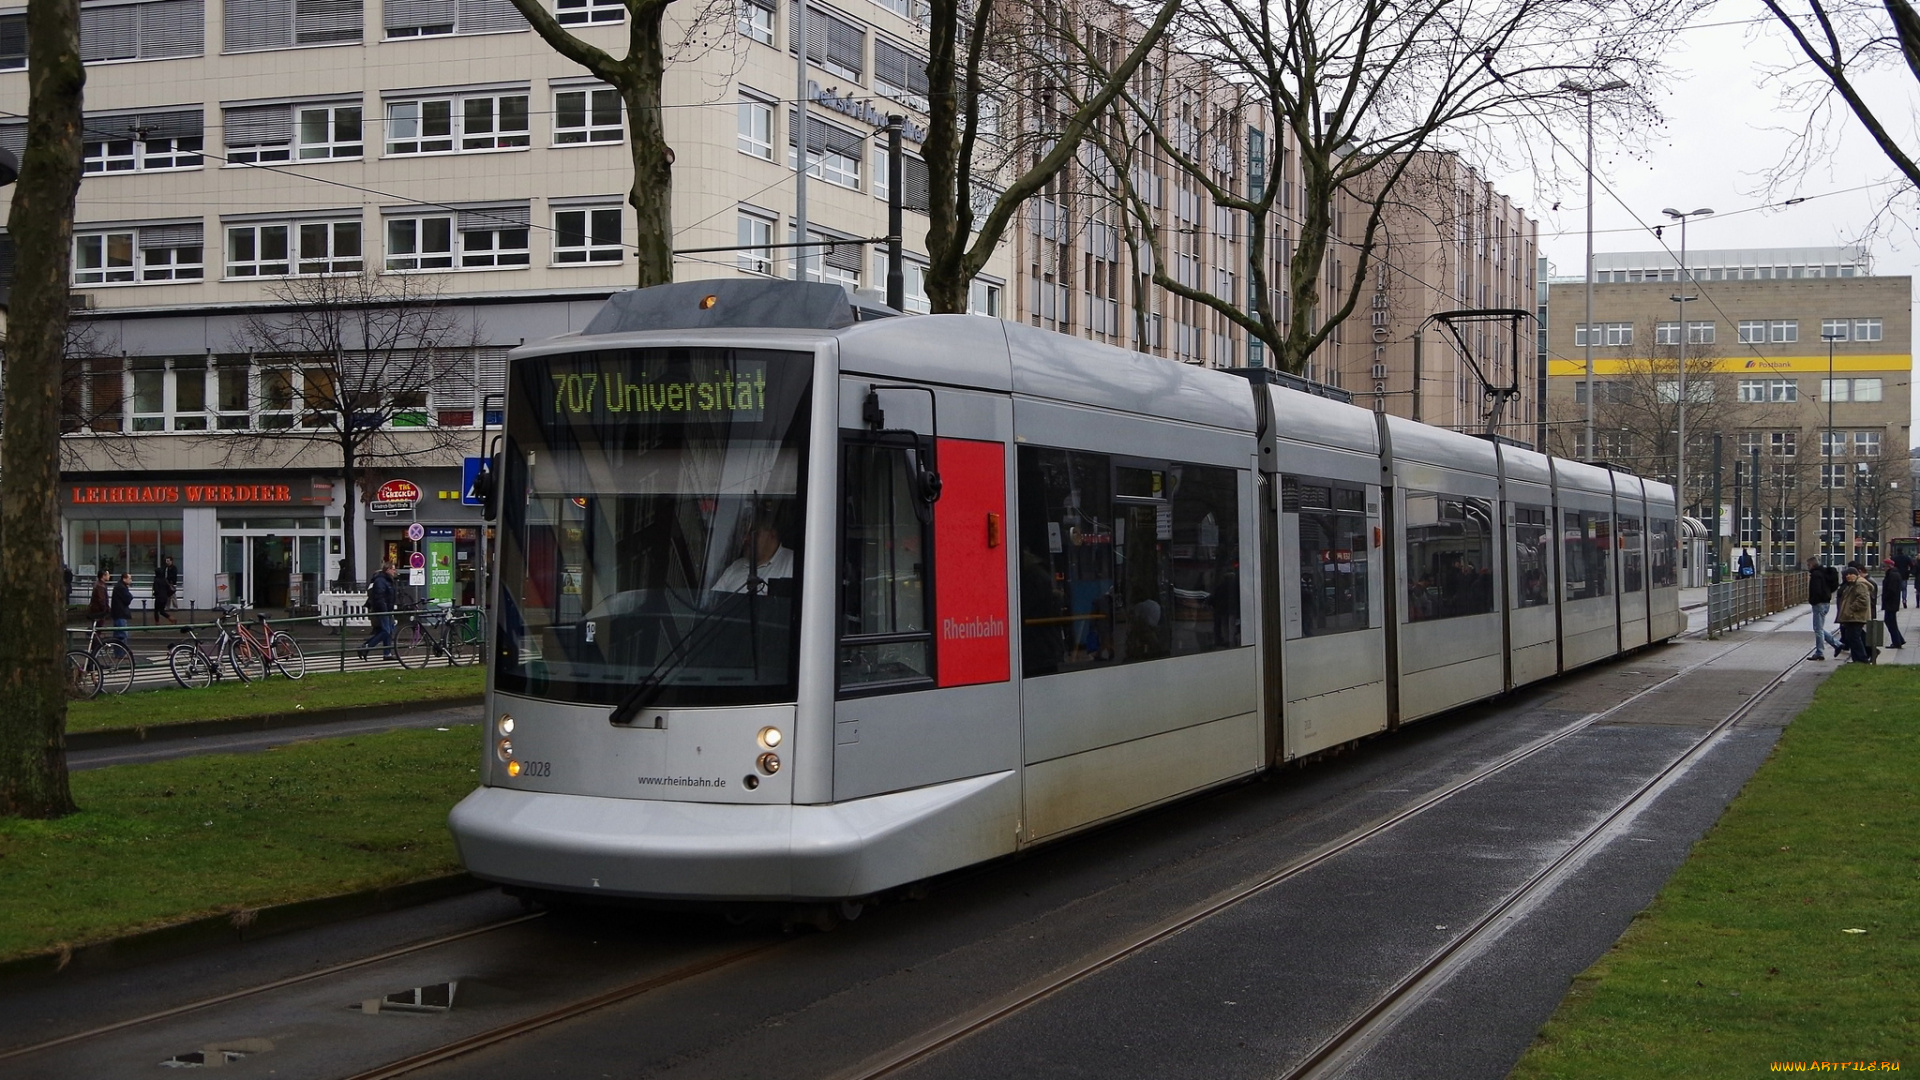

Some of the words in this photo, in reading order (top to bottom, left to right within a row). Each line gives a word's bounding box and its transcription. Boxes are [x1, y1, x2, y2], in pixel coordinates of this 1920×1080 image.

[1758, 360, 1792, 369] Postbank
[552, 373, 598, 414] 707
[604, 368, 766, 413] Universität
[72, 486, 179, 504] LEIHHAUS
[184, 485, 292, 502] WERDIER
[385, 490, 416, 498] CHICKEN
[431, 576, 450, 585] DORF
[943, 614, 1004, 640] Rheinbahn
[523, 761, 551, 777] 2028
[638, 775, 726, 788] www.rheinbahn.de
